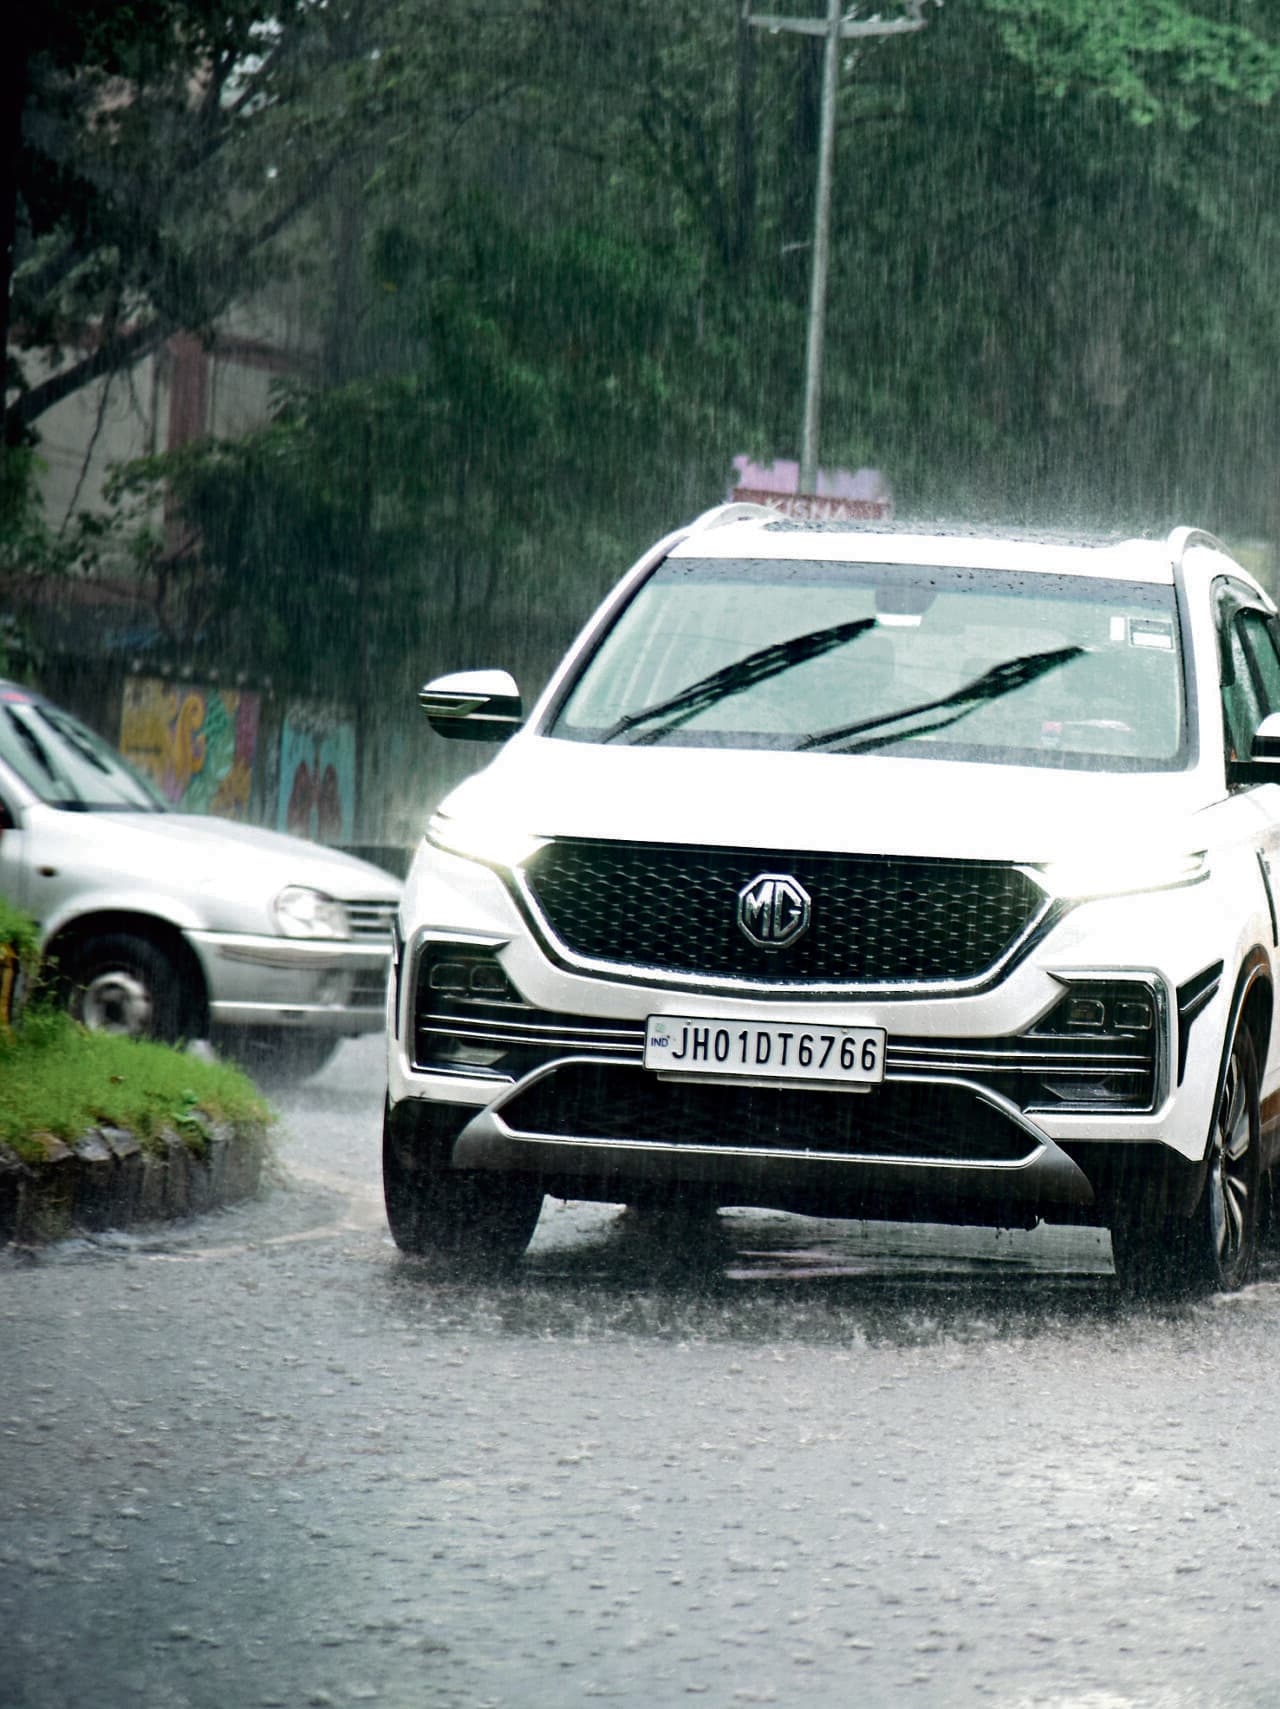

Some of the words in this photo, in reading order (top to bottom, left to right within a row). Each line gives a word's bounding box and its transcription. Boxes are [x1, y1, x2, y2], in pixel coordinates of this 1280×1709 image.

[745, 880, 802, 937] MG
[650, 1037, 669, 1048] IND
[671, 1026, 877, 1071] JH01DT6766
